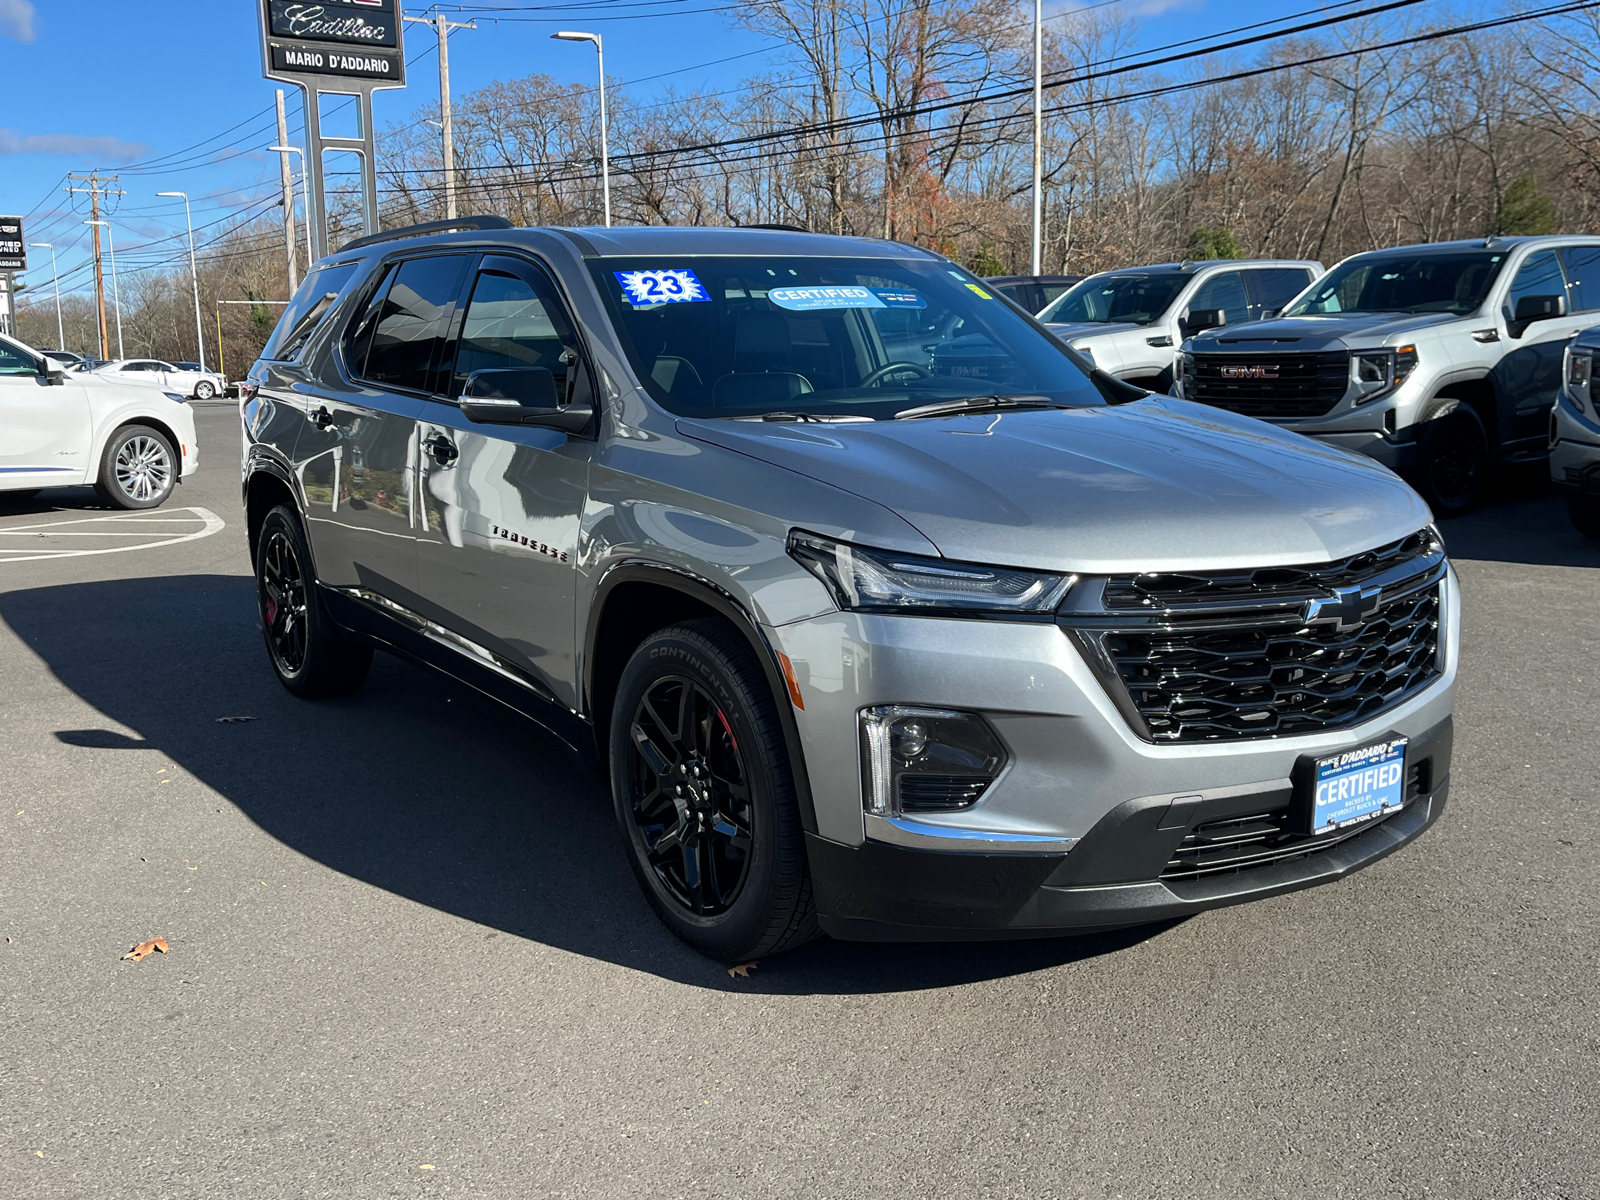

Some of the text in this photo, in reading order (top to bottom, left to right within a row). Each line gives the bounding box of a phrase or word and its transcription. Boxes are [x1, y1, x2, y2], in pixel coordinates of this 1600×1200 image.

[284, 4, 385, 40] Cadillac
[286, 51, 389, 72] MARIO D'ADDARIO
[641, 276, 684, 296] 23
[772, 289, 868, 300] CERTIFIED
[1221, 365, 1280, 378] GMC
[492, 524, 568, 562] TRAVERSE
[1340, 744, 1388, 765] D'ADDARIO
[1390, 738, 1408, 747] GMC
[1316, 763, 1401, 806] CERTIFIED
[1327, 806, 1356, 820] CHEVROLET
[1356, 801, 1371, 811] BUICK
[1377, 796, 1388, 805] GMC
[1345, 794, 1372, 807] BACKED BY
[1315, 824, 1336, 835] NISSAN
[1372, 810, 1381, 818] CT
